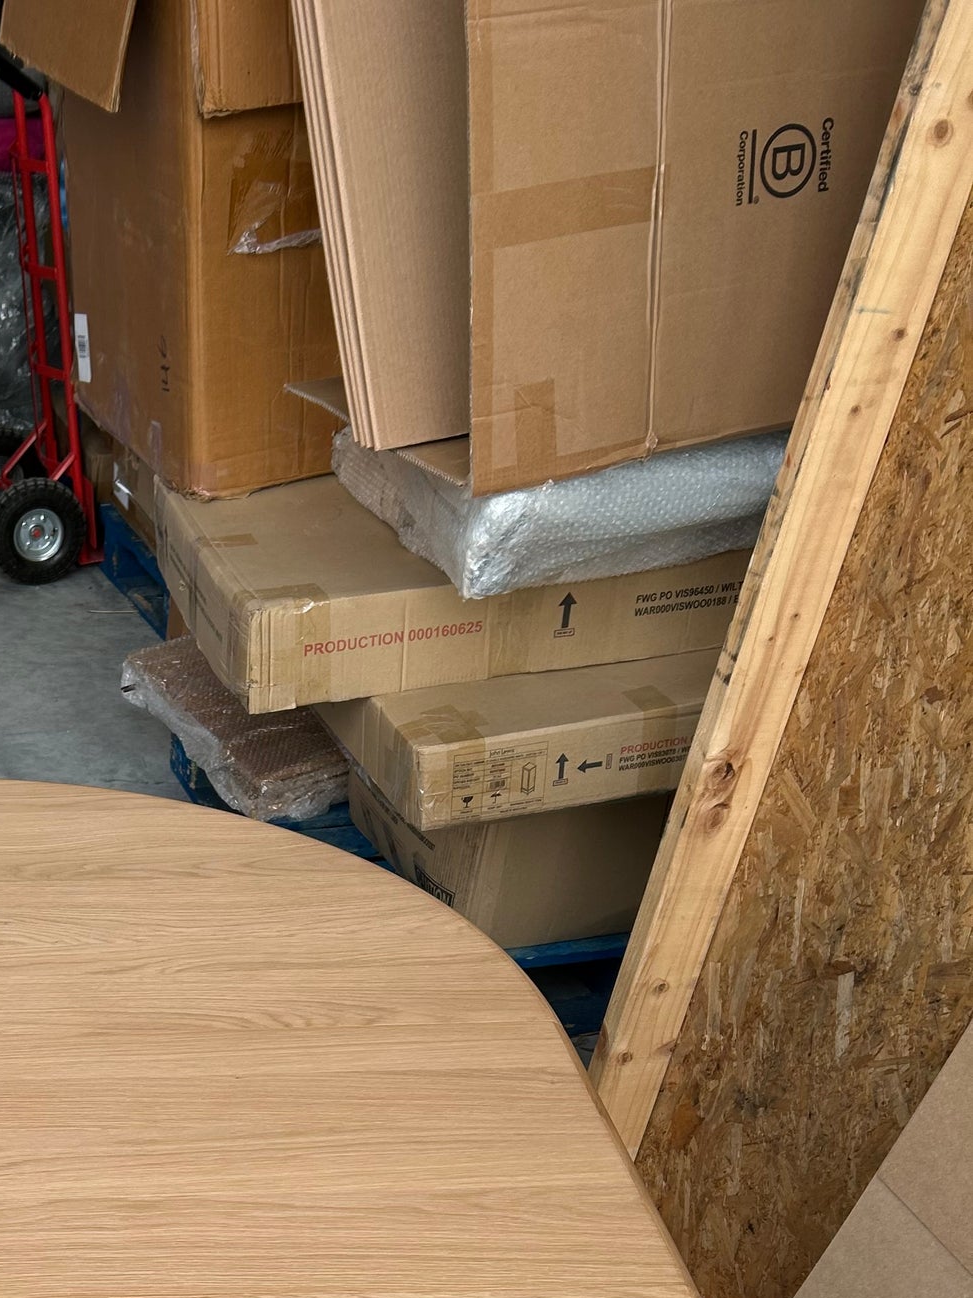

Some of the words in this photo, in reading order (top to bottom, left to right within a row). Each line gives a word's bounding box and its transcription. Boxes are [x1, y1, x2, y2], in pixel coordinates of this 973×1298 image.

[735, 130, 749, 206] Corporation
[771, 143, 806, 181] B
[818, 117, 834, 192] Certified
[635, 593, 658, 604] FWG
[659, 591, 672, 601] PO
[304, 630, 405, 656] PRODUCTION
[408, 620, 483, 642] 000160625
[620, 736, 687, 755] PRODUCTION
[636, 753, 647, 761] PO
